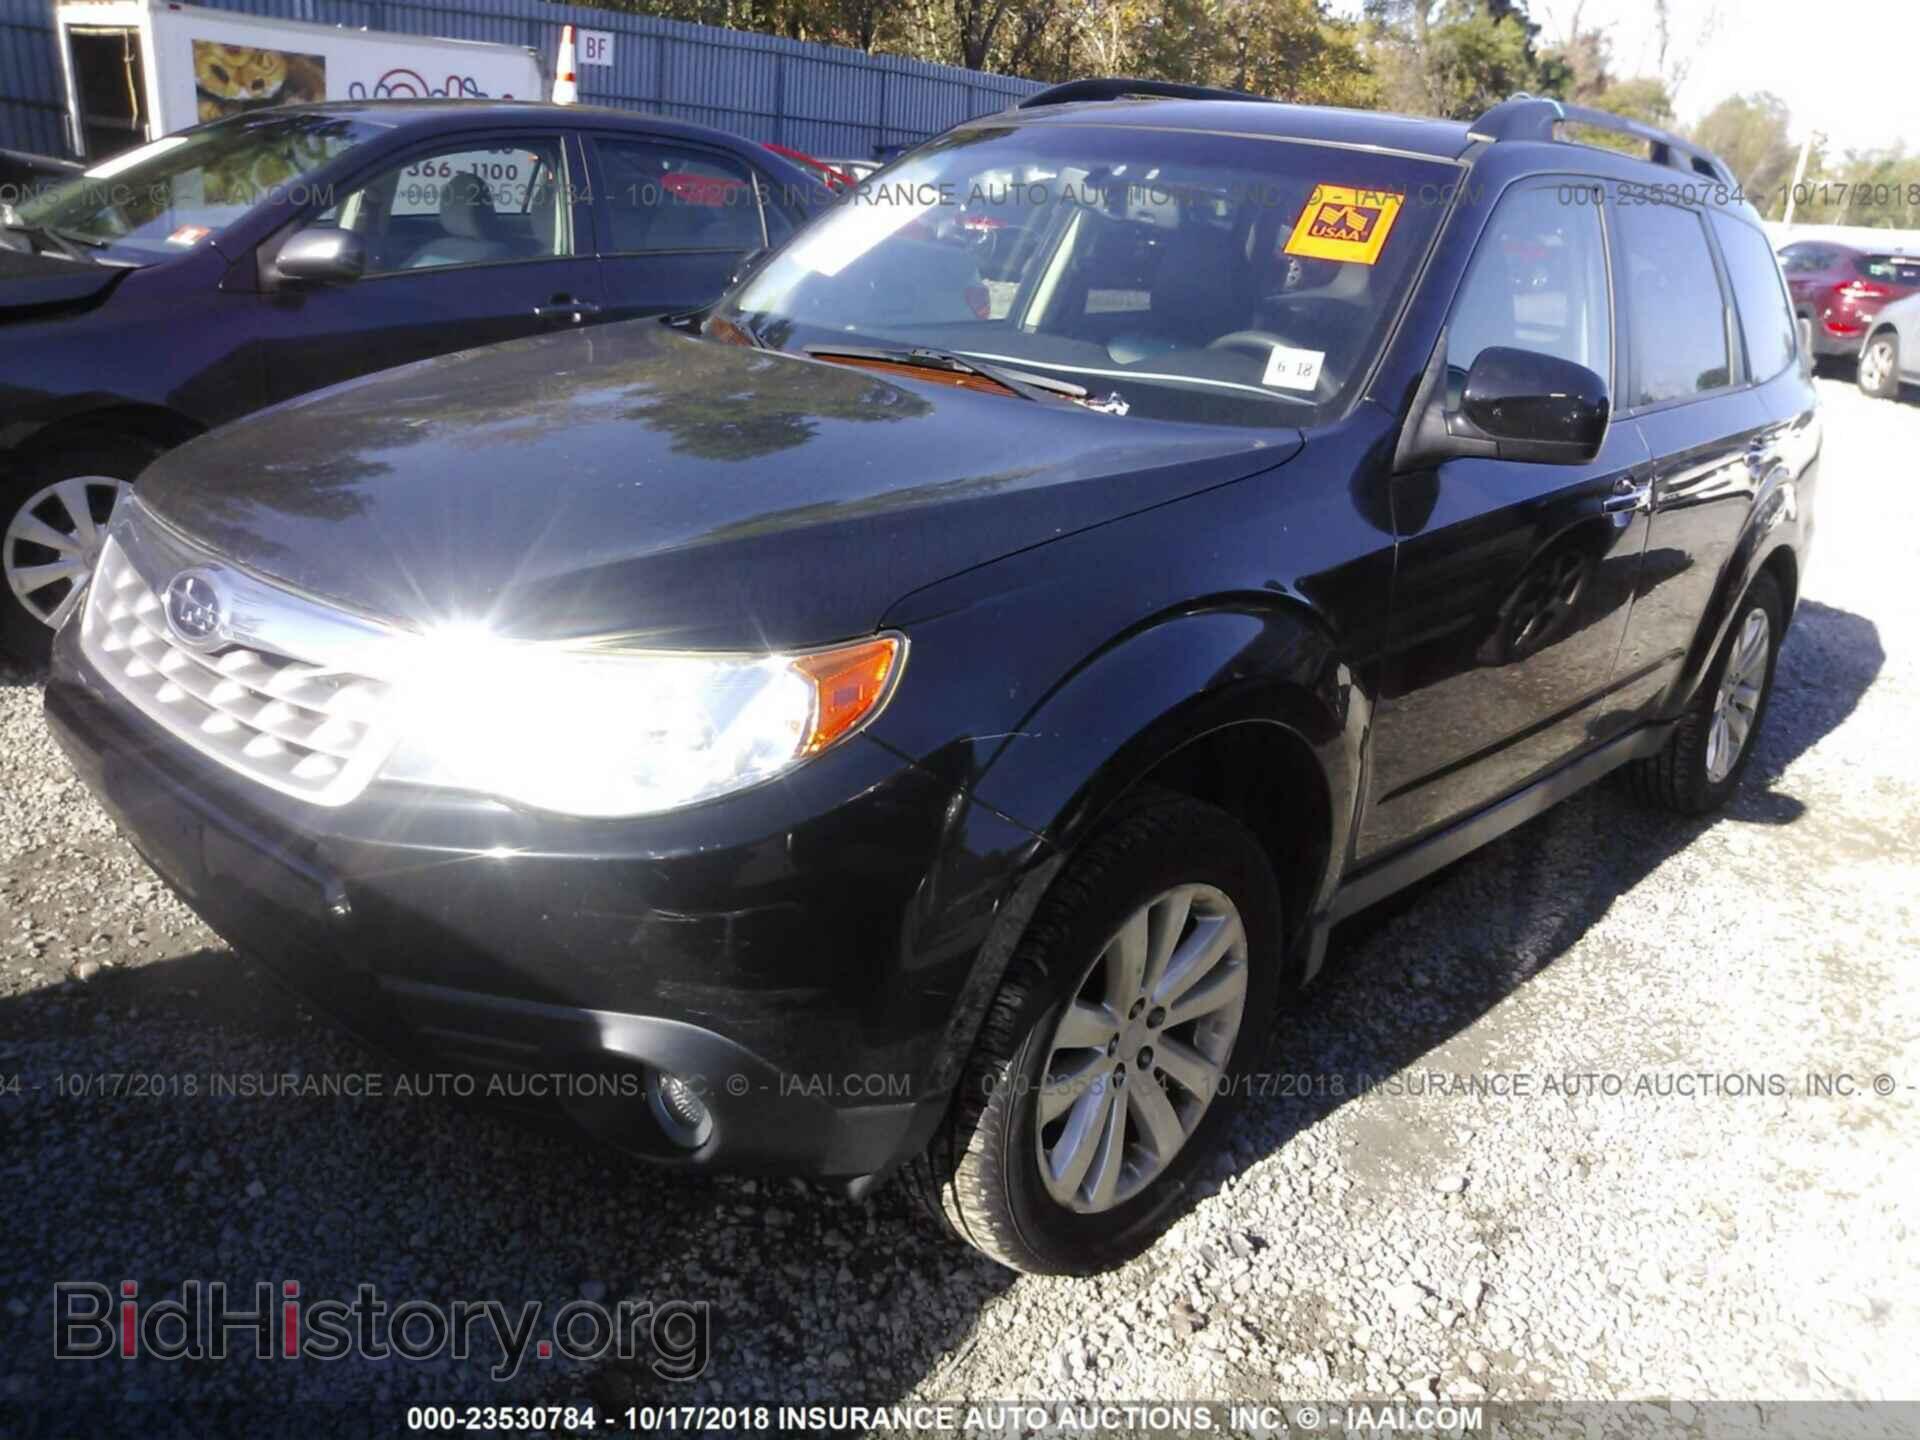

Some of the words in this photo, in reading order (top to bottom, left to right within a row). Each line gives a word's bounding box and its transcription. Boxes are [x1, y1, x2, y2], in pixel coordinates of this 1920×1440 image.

[585, 36, 607, 58] BF
[1311, 225, 1360, 241] USAA
[1296, 362, 1312, 376] 18
